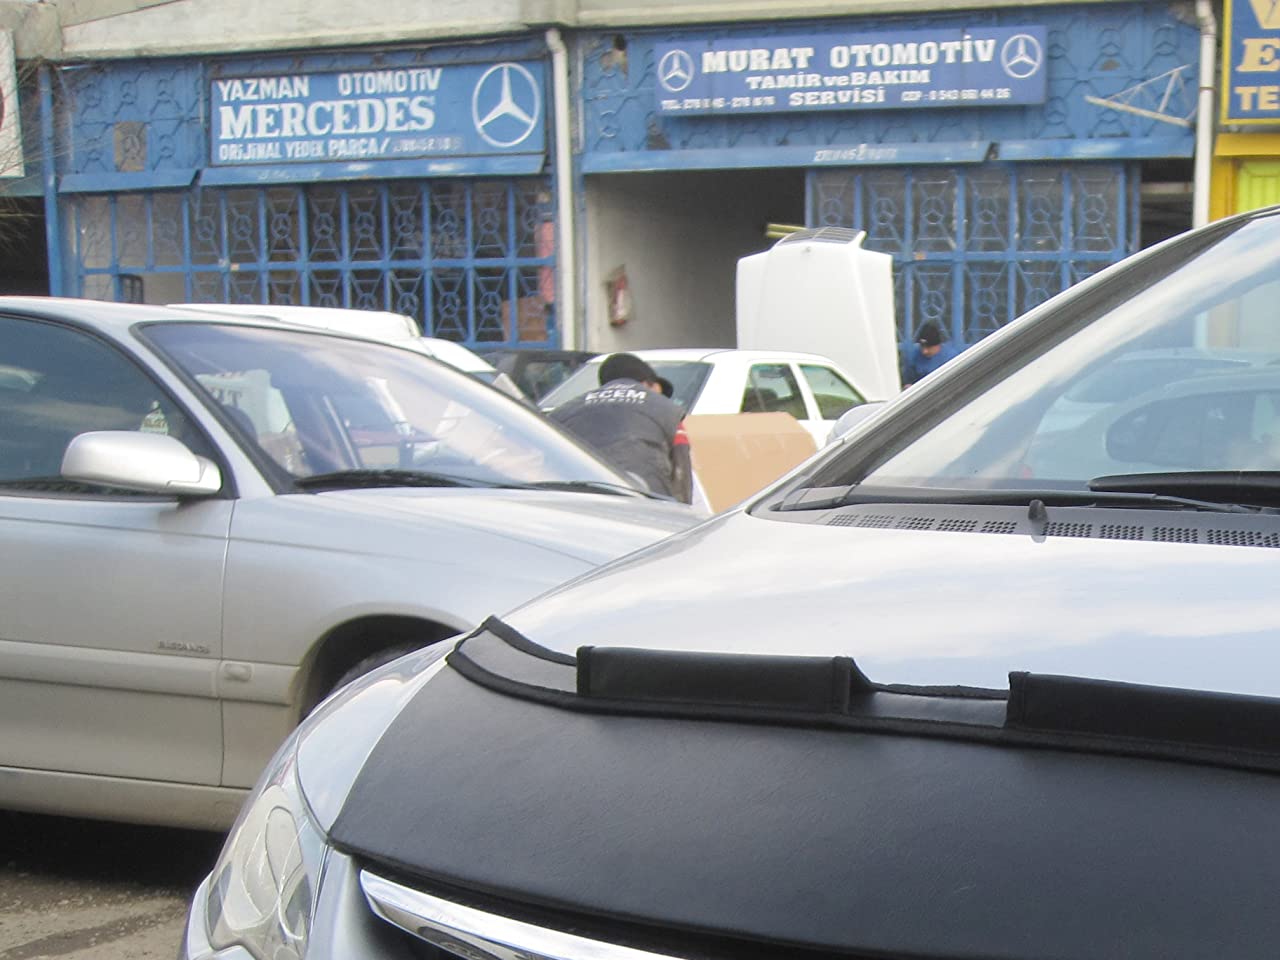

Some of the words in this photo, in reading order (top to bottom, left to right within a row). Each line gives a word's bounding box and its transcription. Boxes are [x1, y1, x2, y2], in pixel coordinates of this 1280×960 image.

[702, 47, 814, 74] MURAT
[830, 35, 997, 69] OTOMOTİV
[217, 76, 310, 101] YAZMAN
[848, 70, 931, 85] BAKIM
[219, 96, 435, 140] MERCEDES
